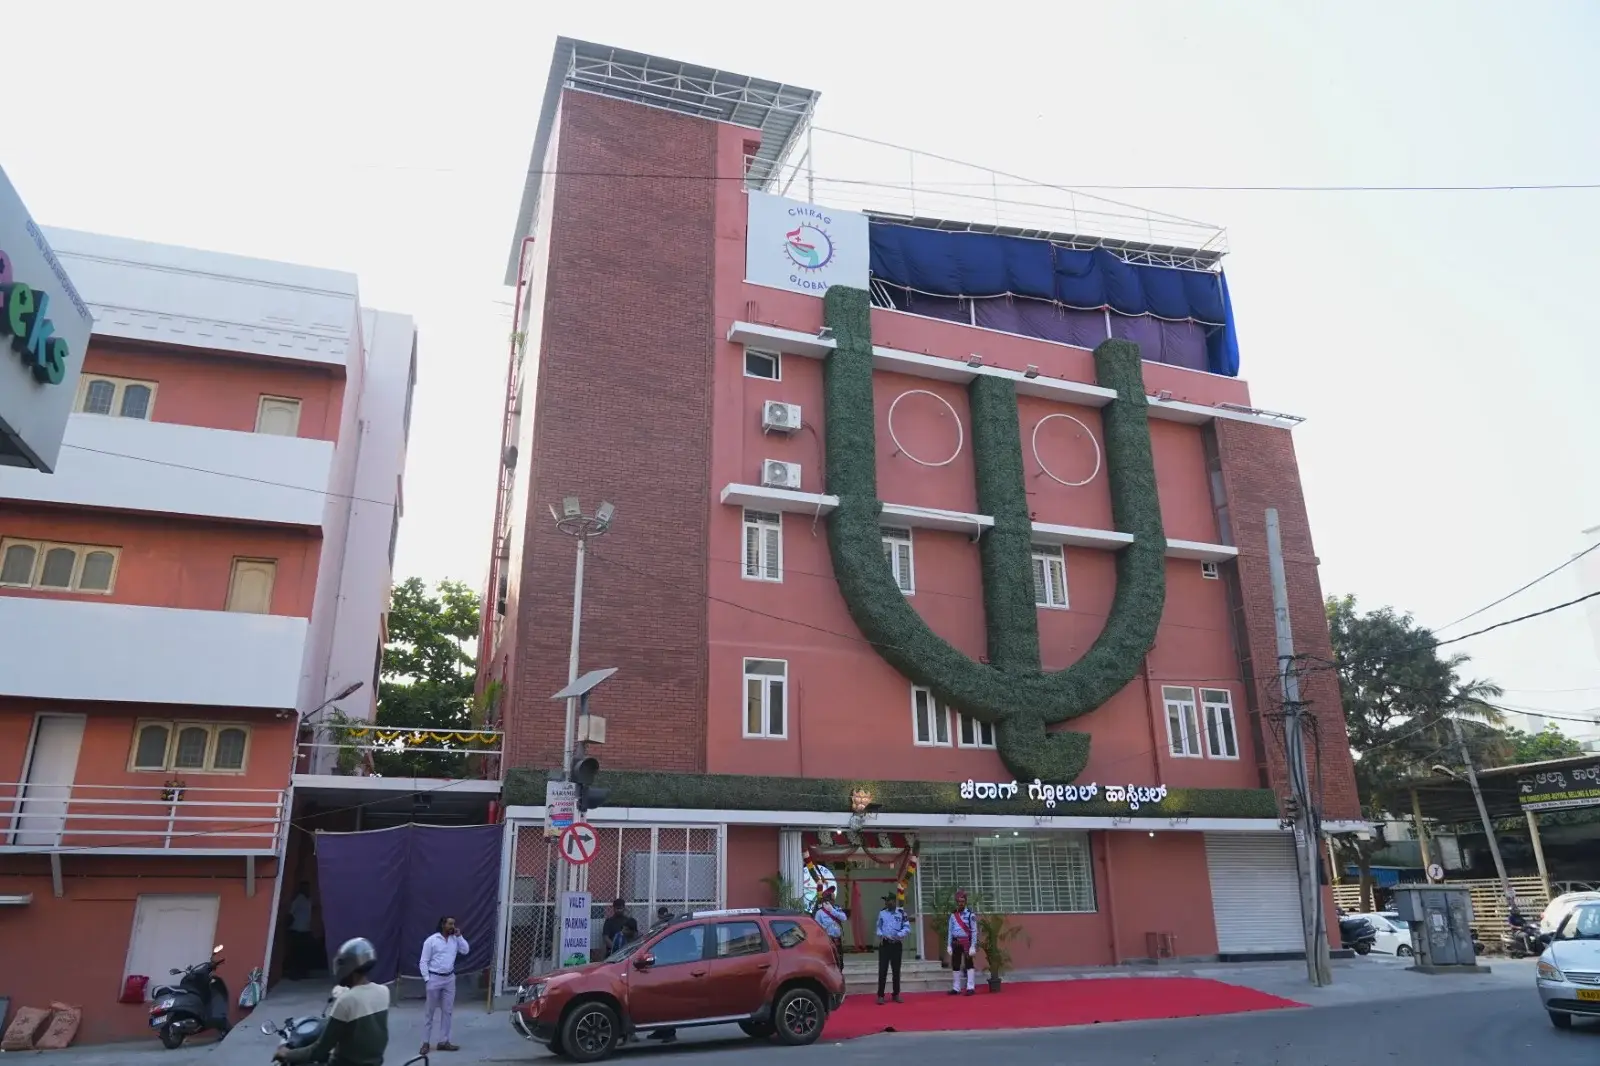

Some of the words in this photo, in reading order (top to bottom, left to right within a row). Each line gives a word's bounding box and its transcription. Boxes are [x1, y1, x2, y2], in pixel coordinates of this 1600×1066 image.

[788, 207, 831, 225] CHIRAG
[789, 274, 828, 290] GLOBAL
[960, 778, 1018, 800] ಚಿರಾಗ್
[1028, 778, 1098, 809] ಗ್ಲೋಬಲ್
[1105, 783, 1168, 810] ಹಾಸ್ಪಿಟಲ್
[568, 896, 585, 909] VALET
[564, 917, 588, 929] PARKING
[564, 937, 588, 948] AVAILABLE
